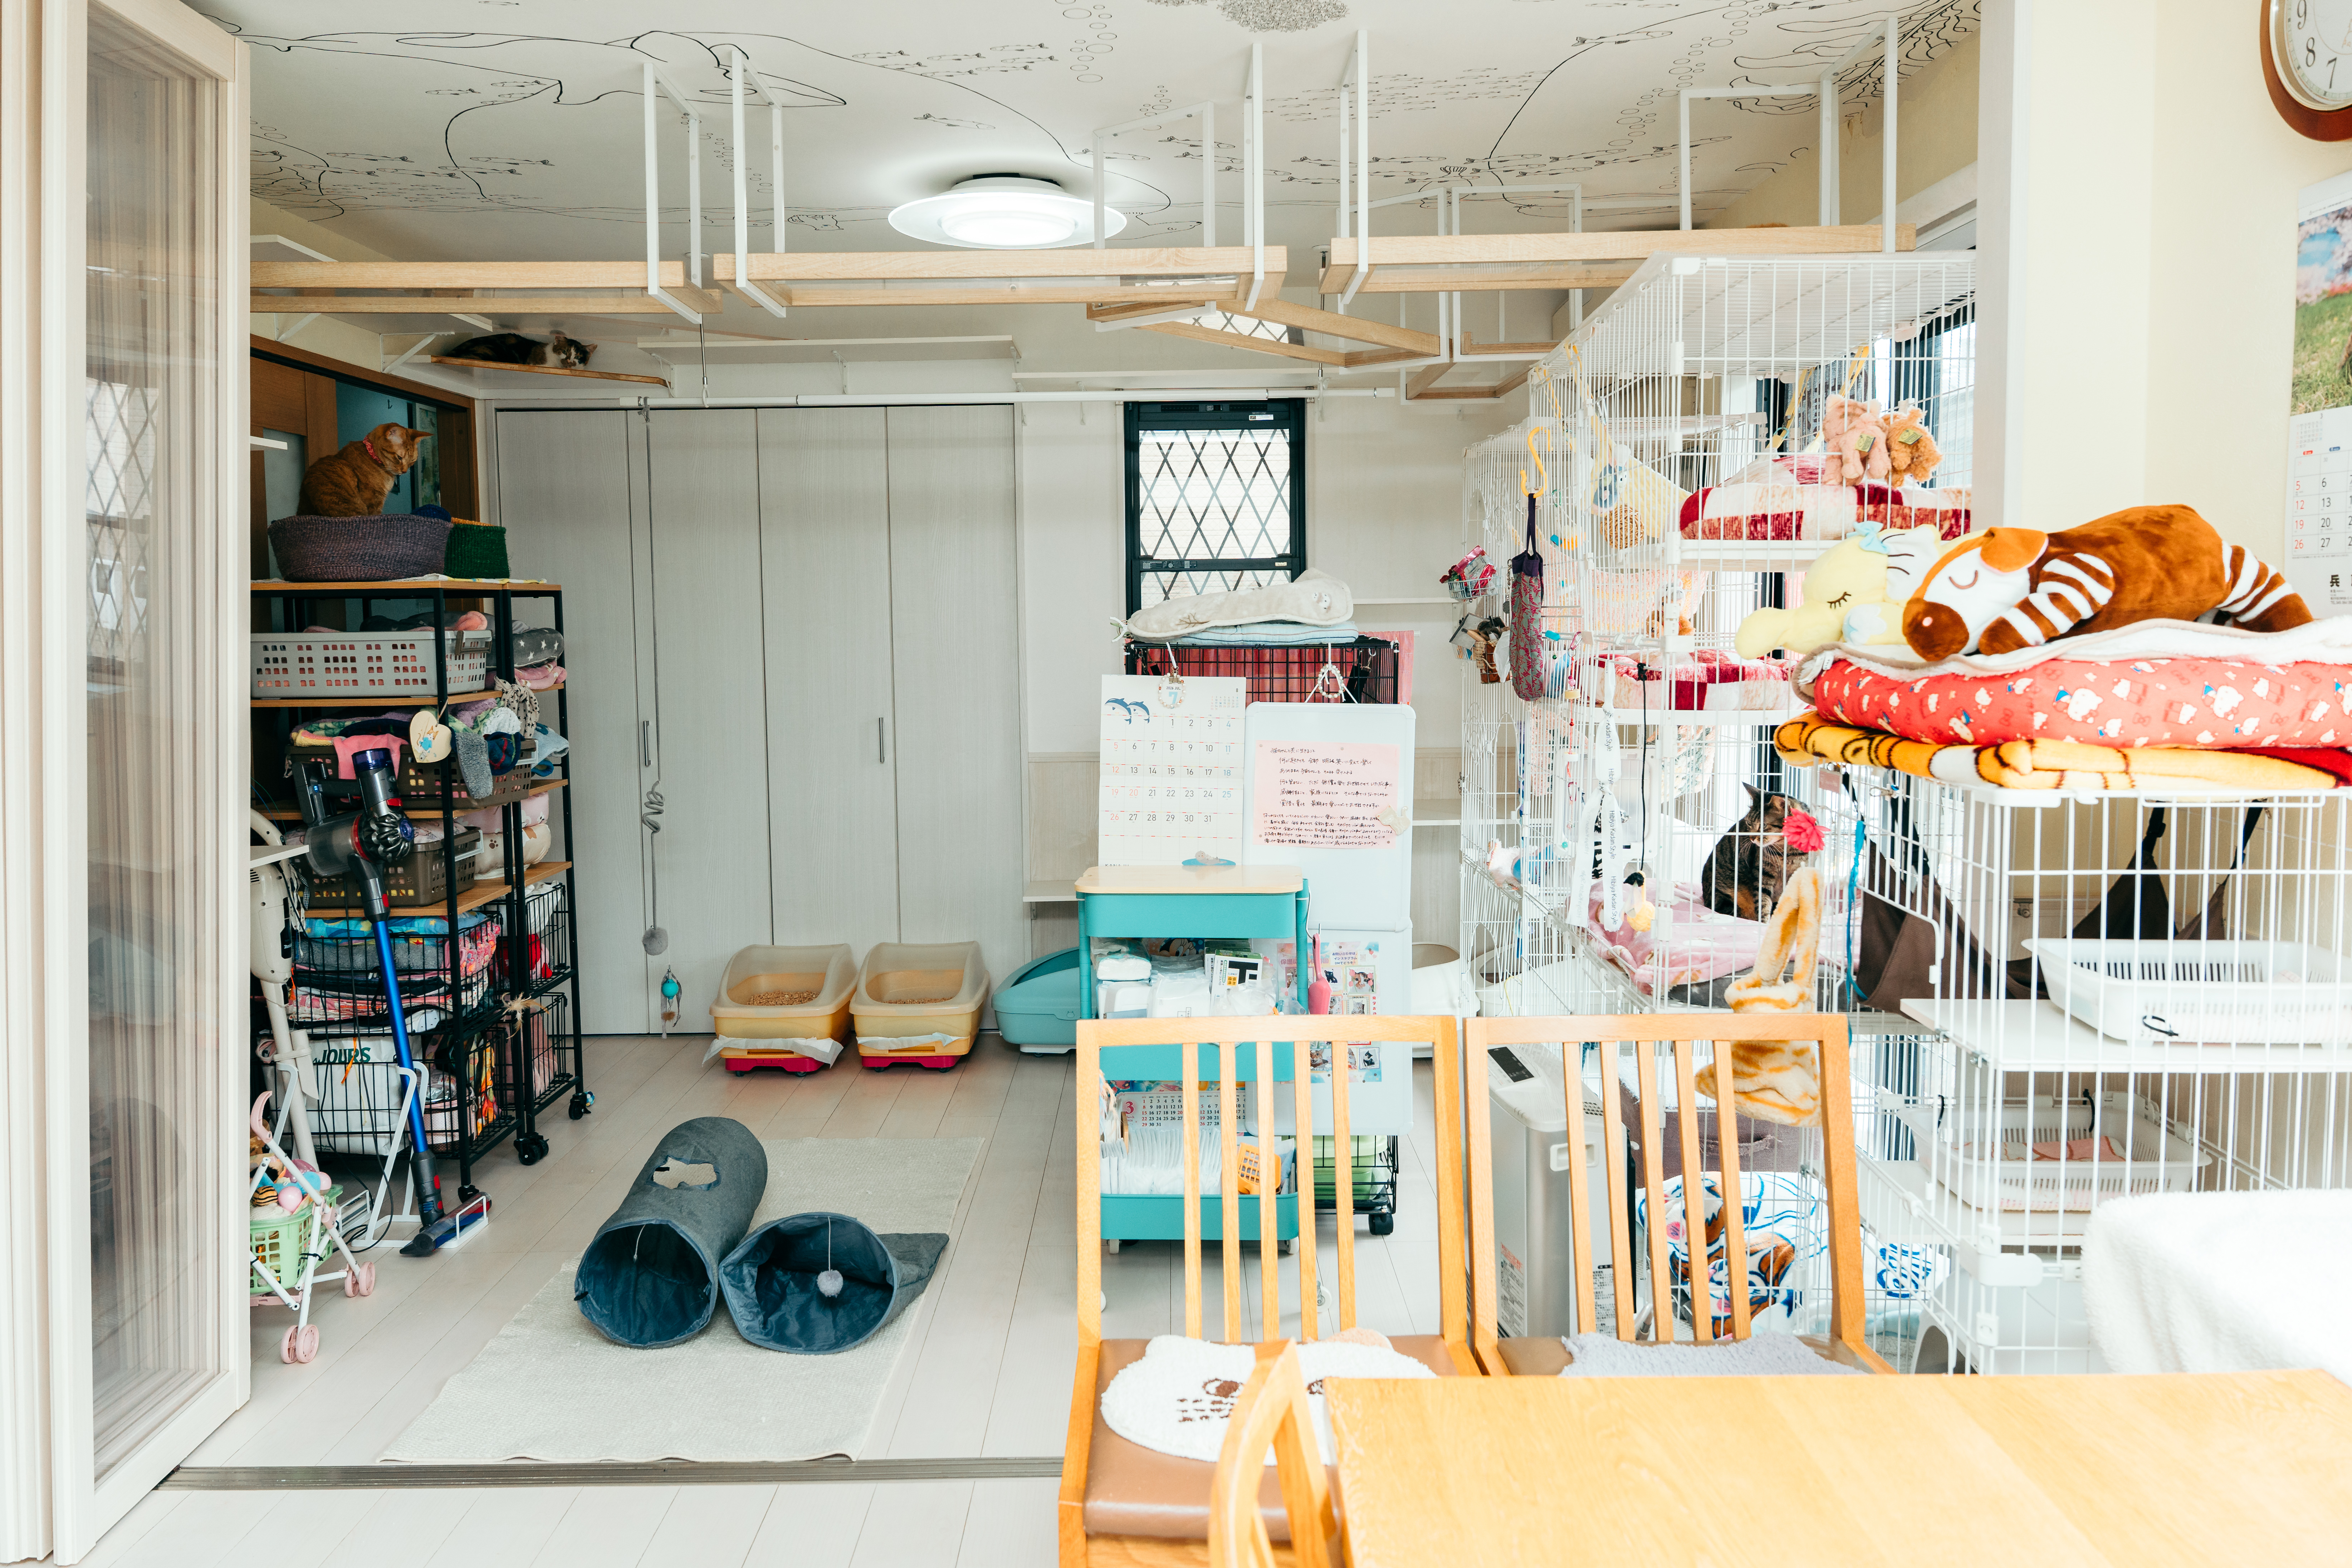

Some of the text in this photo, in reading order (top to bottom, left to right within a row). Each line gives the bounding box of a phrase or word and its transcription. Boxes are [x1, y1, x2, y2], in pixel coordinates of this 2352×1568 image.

[2297, 0, 2307, 30] 9
[2306, 37, 2316, 67] 8
[2326, 57, 2337, 89] 7
[2296, 478, 2326, 490] 5 6
[2296, 497, 2331, 509] 12 13
[2295, 518, 2330, 529] 19 20
[2295, 538, 2330, 549] 26 27
[2330, 575, 2339, 587] 兵
[1169, 692, 1178, 709] 7
[1280, 799, 1305, 807] 覚悟と責任
[319, 1047, 371, 1063] JOURS
[1125, 1101, 1134, 1114] 3
